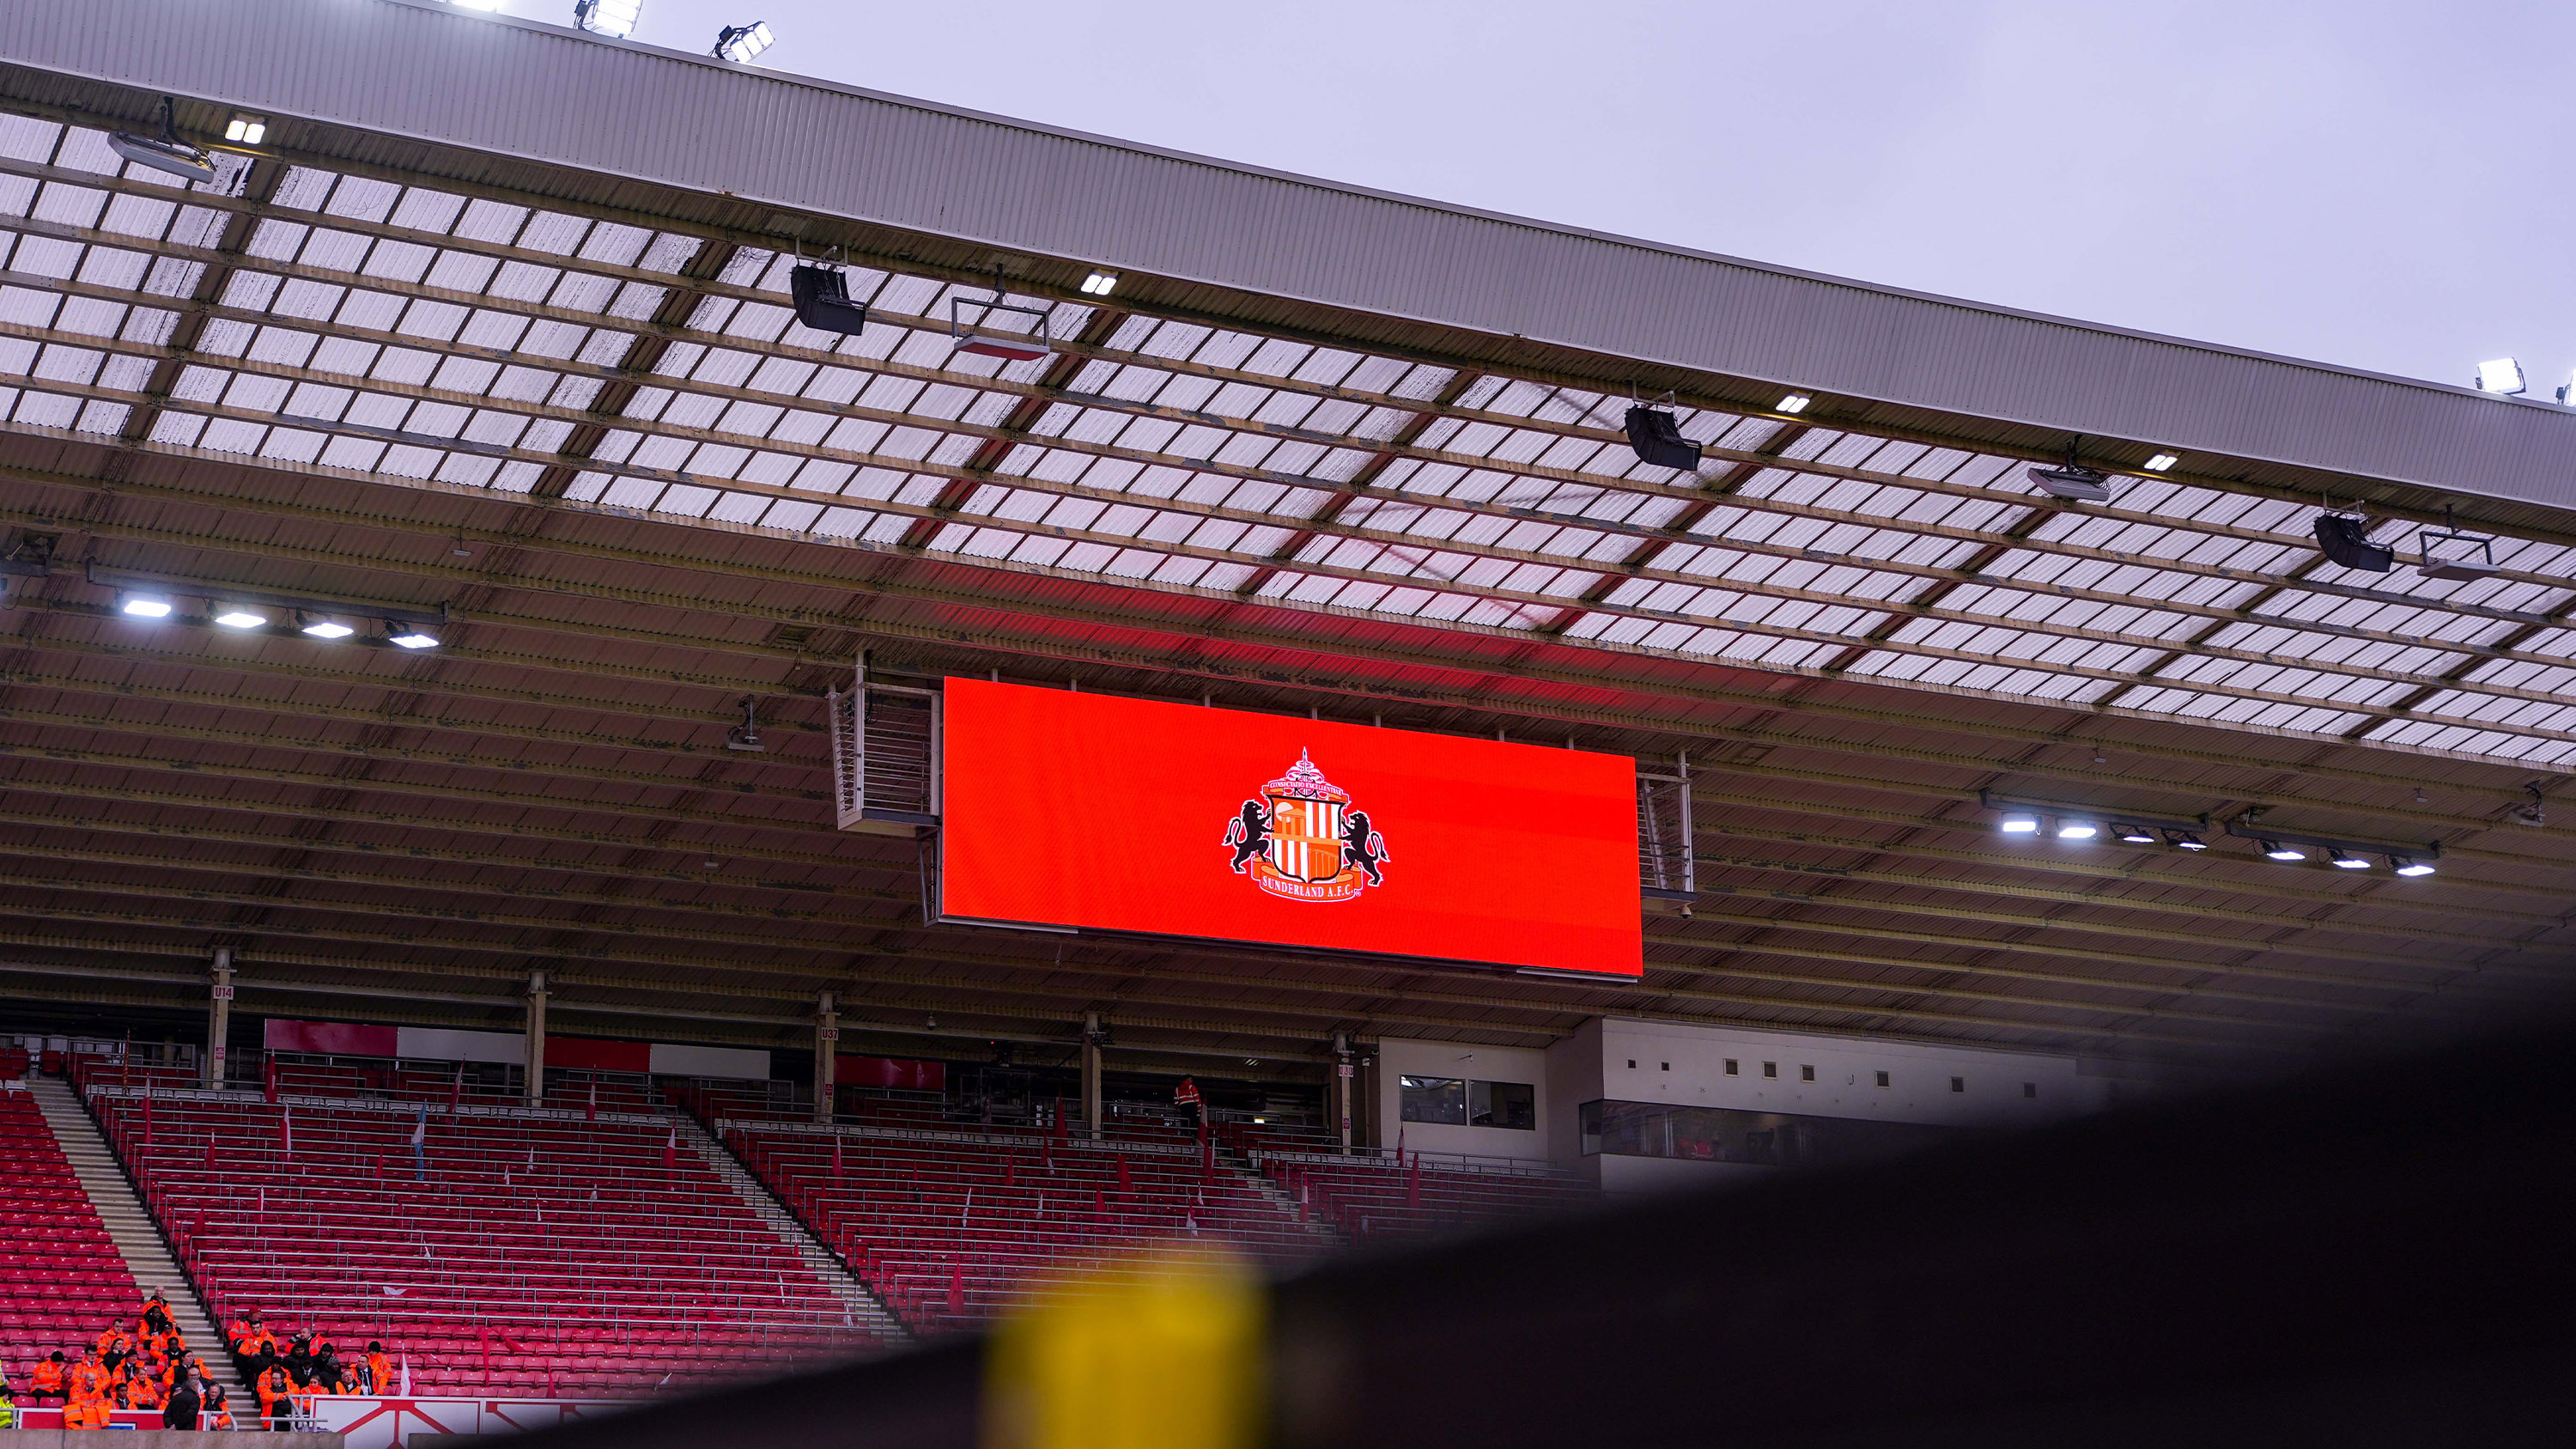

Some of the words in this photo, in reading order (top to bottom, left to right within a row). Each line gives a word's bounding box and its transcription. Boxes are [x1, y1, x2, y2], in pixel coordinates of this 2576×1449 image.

[1262, 875, 1325, 898] SUNDERLAND
[1327, 884, 1353, 898] A.F.C.
[215, 987, 232, 997] U14
[822, 1029, 838, 1038] U37
